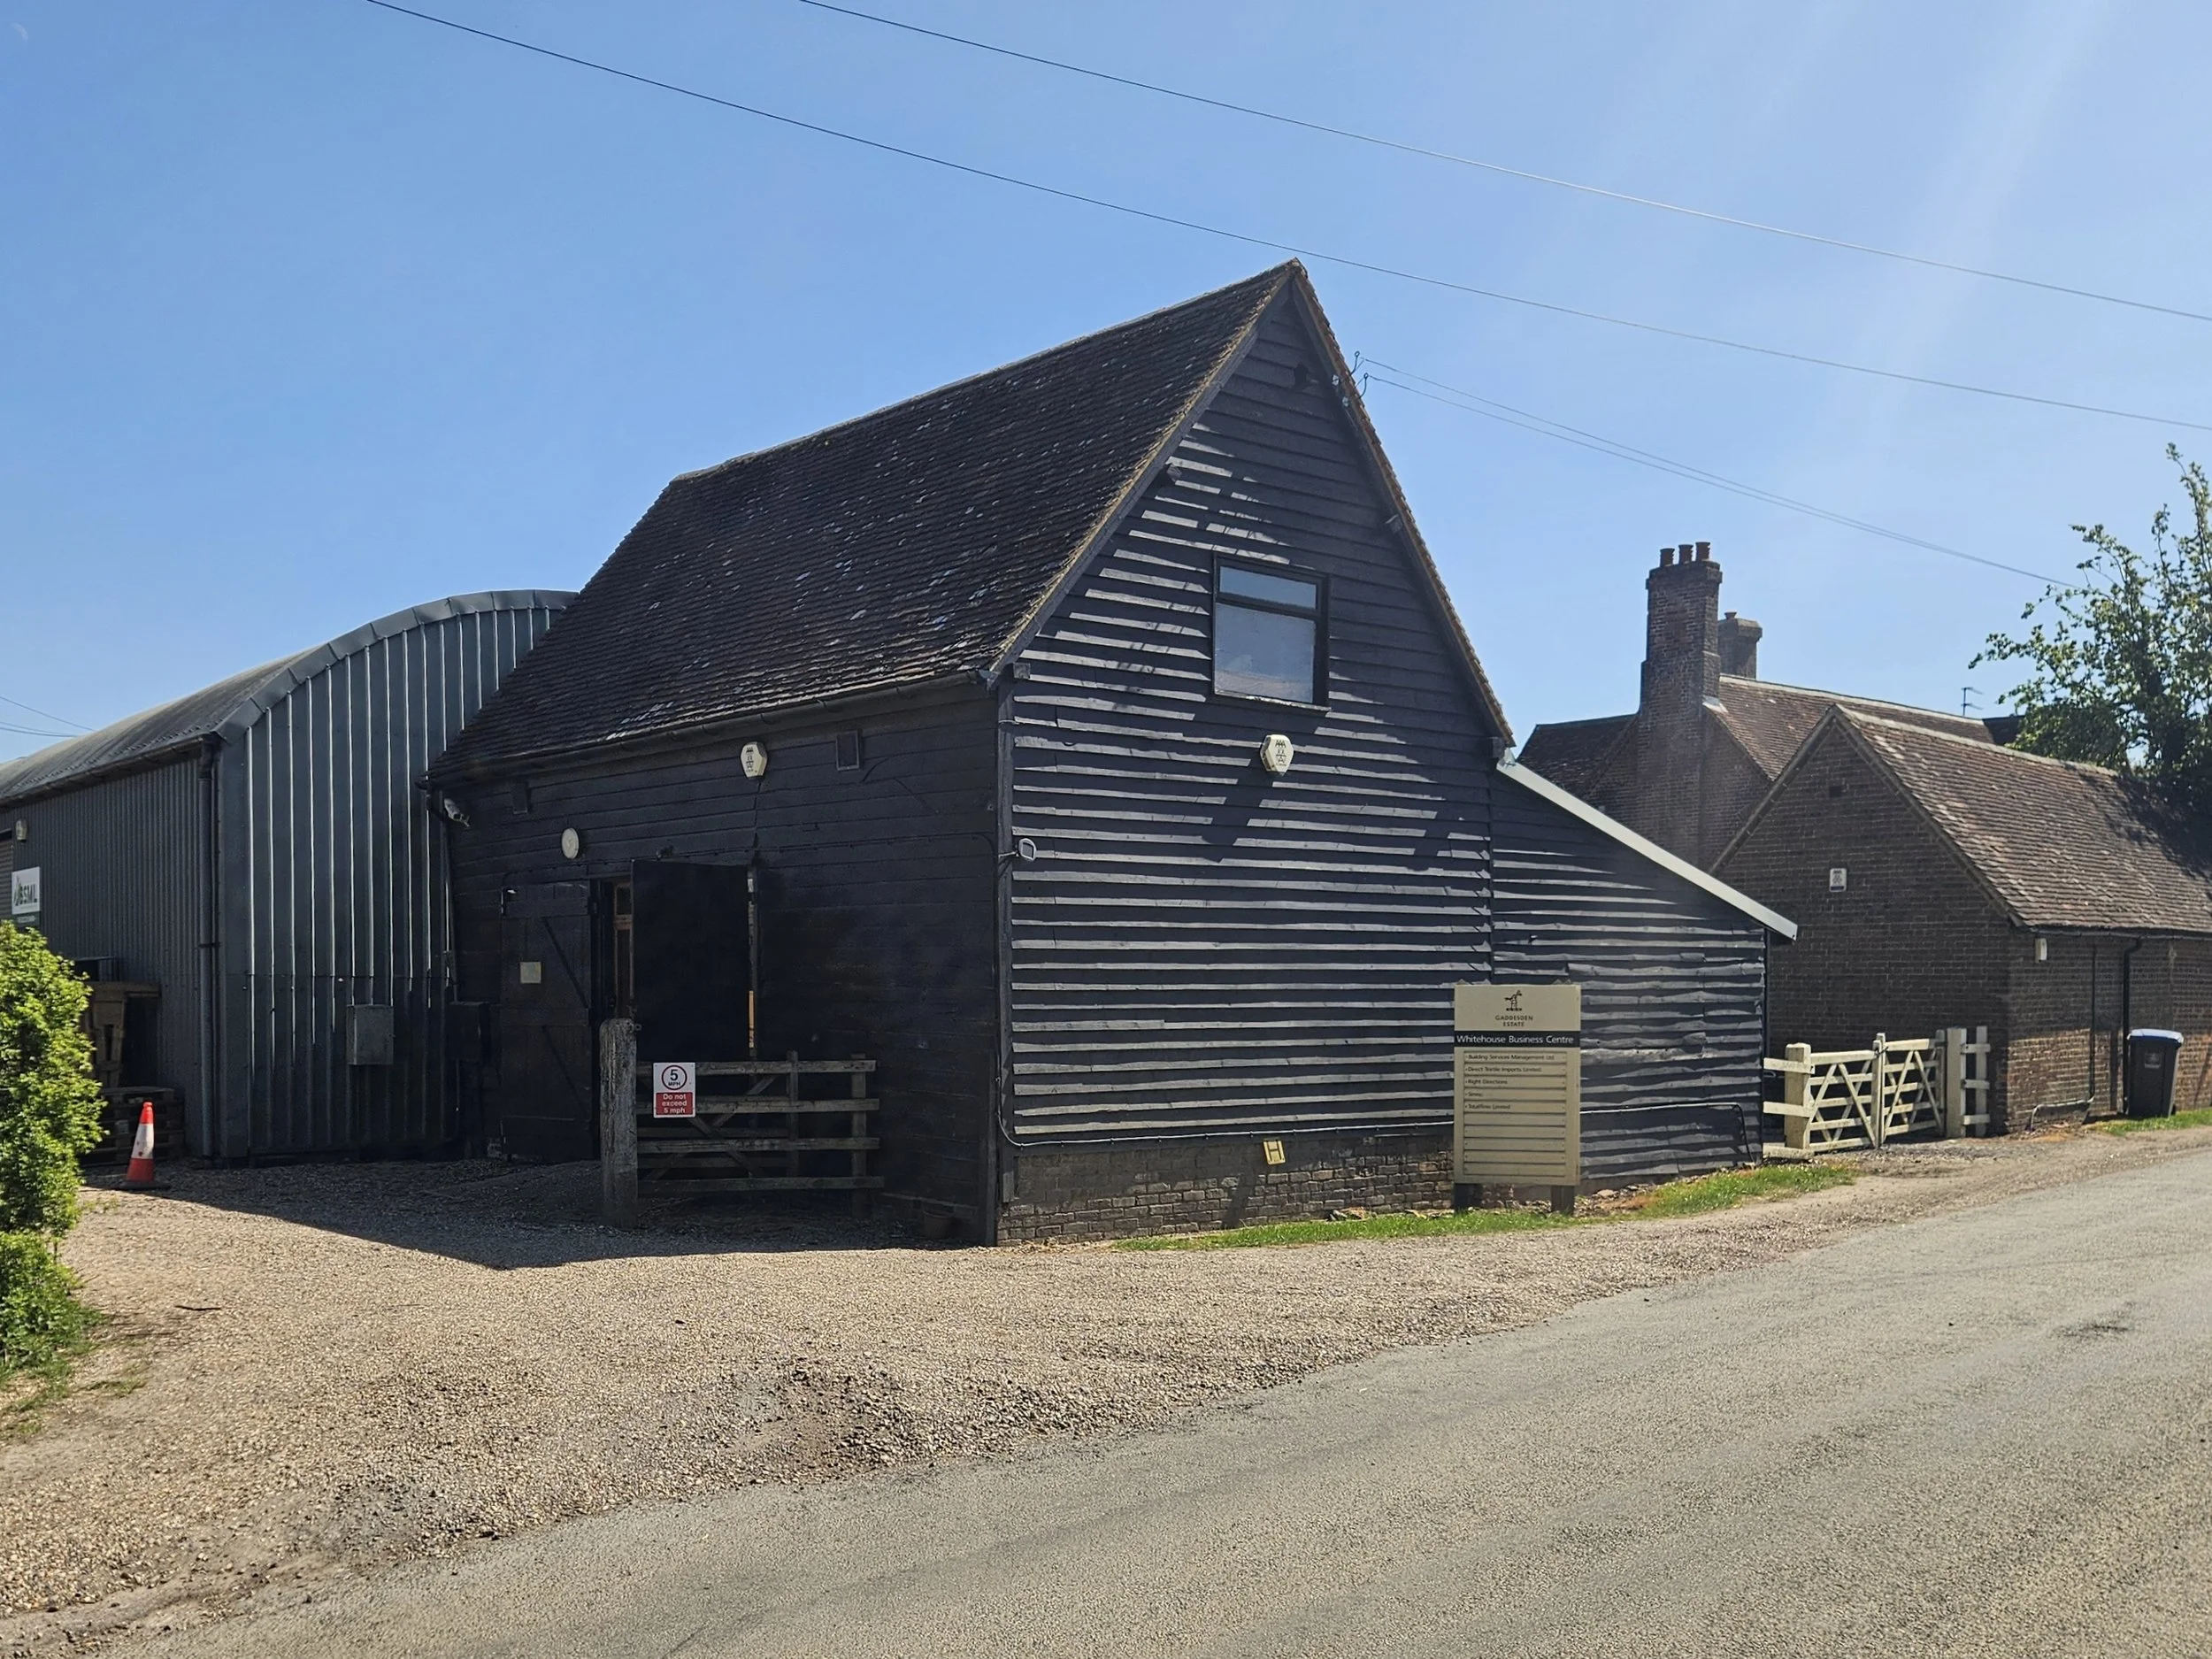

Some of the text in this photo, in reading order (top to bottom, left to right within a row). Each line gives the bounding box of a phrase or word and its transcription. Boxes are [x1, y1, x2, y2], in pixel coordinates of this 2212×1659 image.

[1456, 1035, 1574, 1044] Whitehouse Business Centre
[670, 1069, 679, 1081] 5
[1266, 1140, 1283, 1162] H
